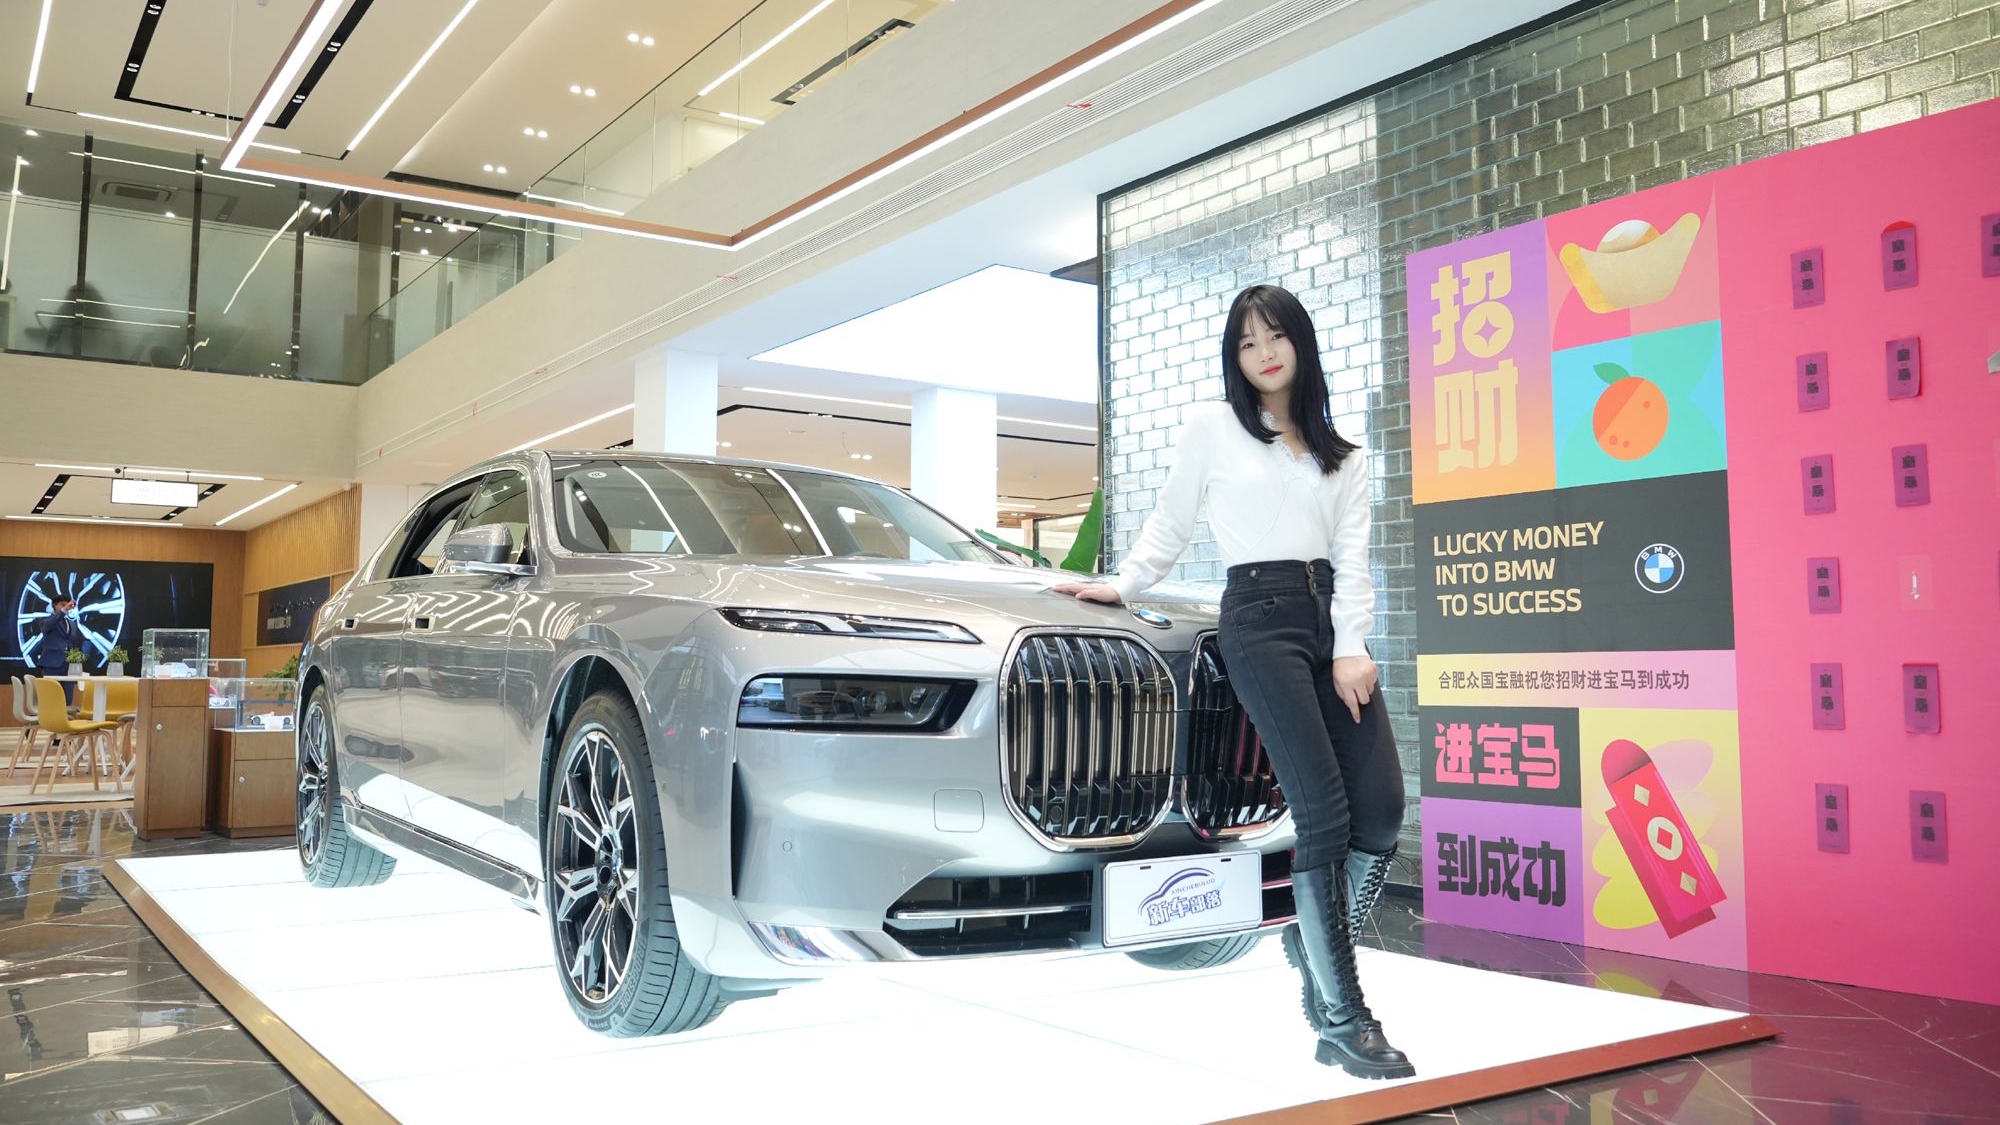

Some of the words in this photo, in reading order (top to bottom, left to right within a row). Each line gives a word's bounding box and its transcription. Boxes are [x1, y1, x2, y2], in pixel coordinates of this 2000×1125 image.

[1431, 250, 1519, 474] 招财
[1433, 529, 1508, 557] LUCKY
[1513, 520, 1605, 552] MONEY
[1435, 562, 1489, 586] INTO
[1495, 557, 1556, 583] BMW
[1437, 593, 1468, 617] TO
[1473, 588, 1583, 615] SUCCESS
[1438, 669, 1690, 691] 合肥众国宝融祝您招财进宝马到成功
[1434, 722, 1561, 790] 进宝马
[1436, 831, 1567, 908] 到成功
[1148, 890, 1222, 926] 新车部落
